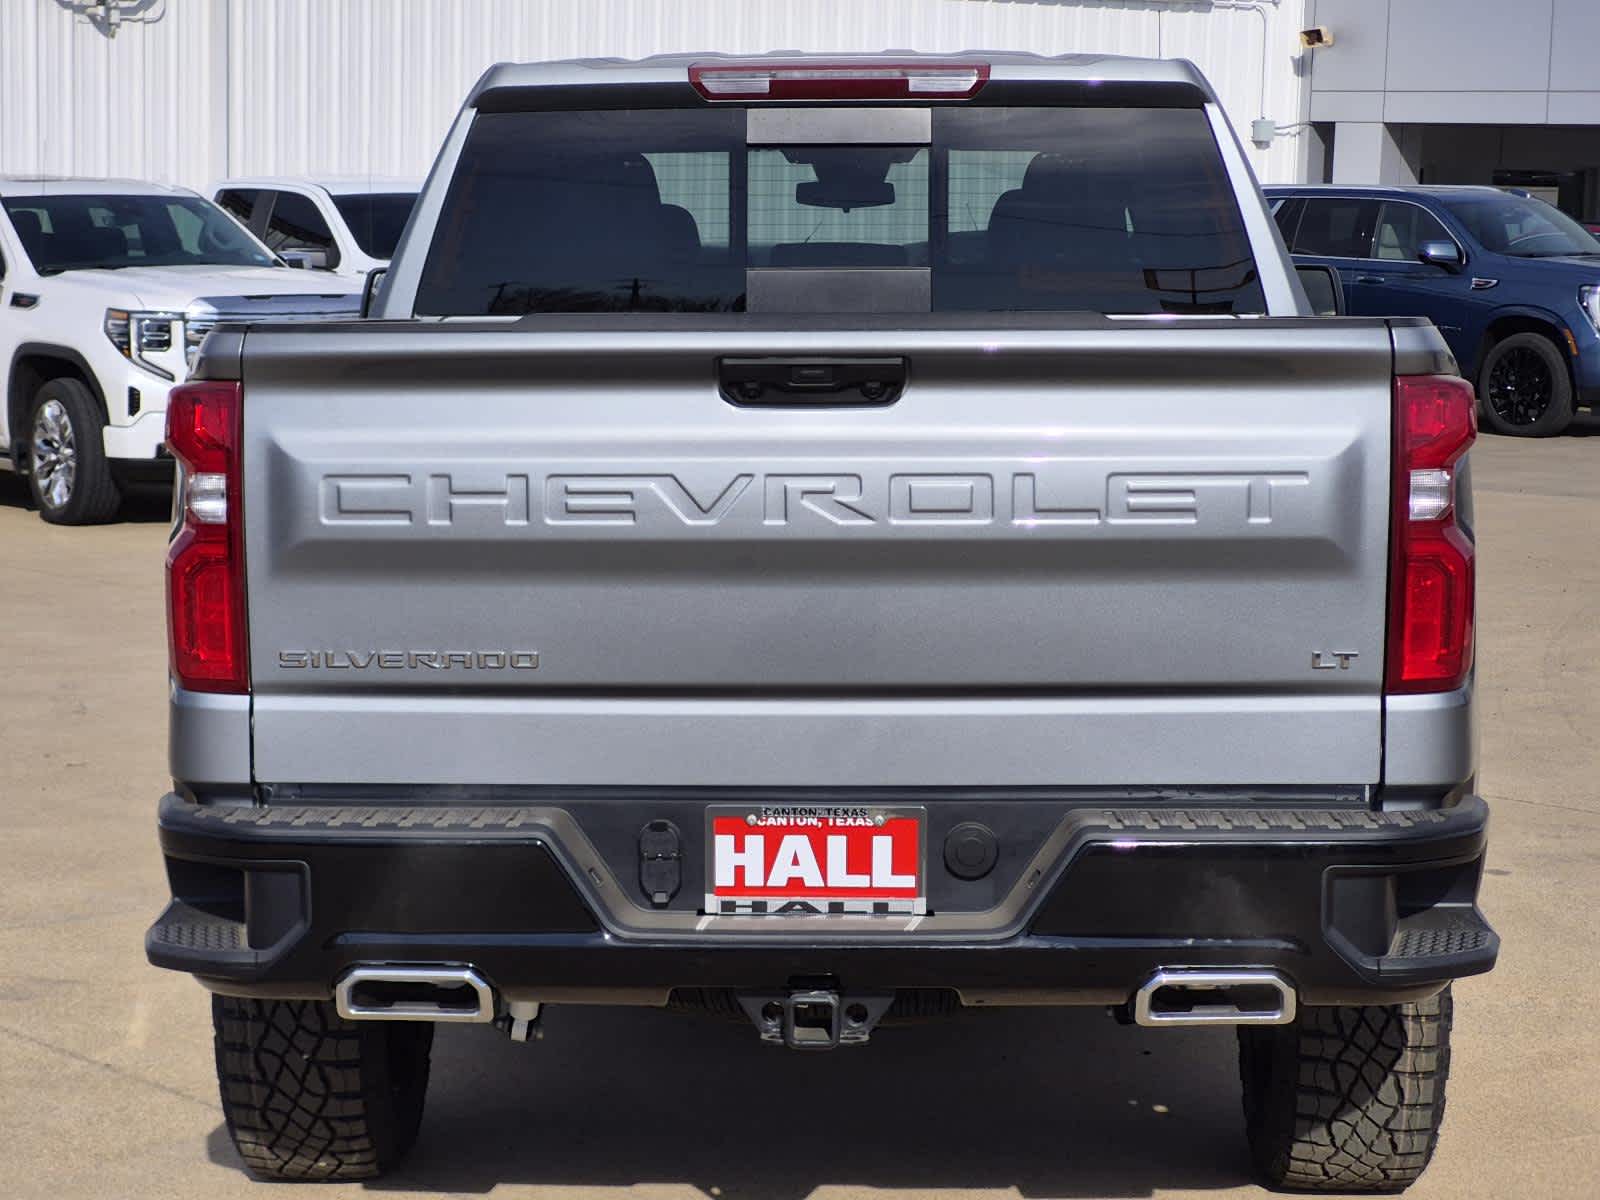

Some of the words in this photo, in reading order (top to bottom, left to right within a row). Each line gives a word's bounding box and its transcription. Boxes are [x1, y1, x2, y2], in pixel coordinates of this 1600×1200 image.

[318, 472, 1310, 527] CHEVROLET
[279, 650, 540, 669] SILVERADO
[1311, 650, 1359, 670] LT
[825, 807, 868, 816] TEXAS
[826, 816, 875, 827] TEXAS
[714, 834, 916, 889] HALL
